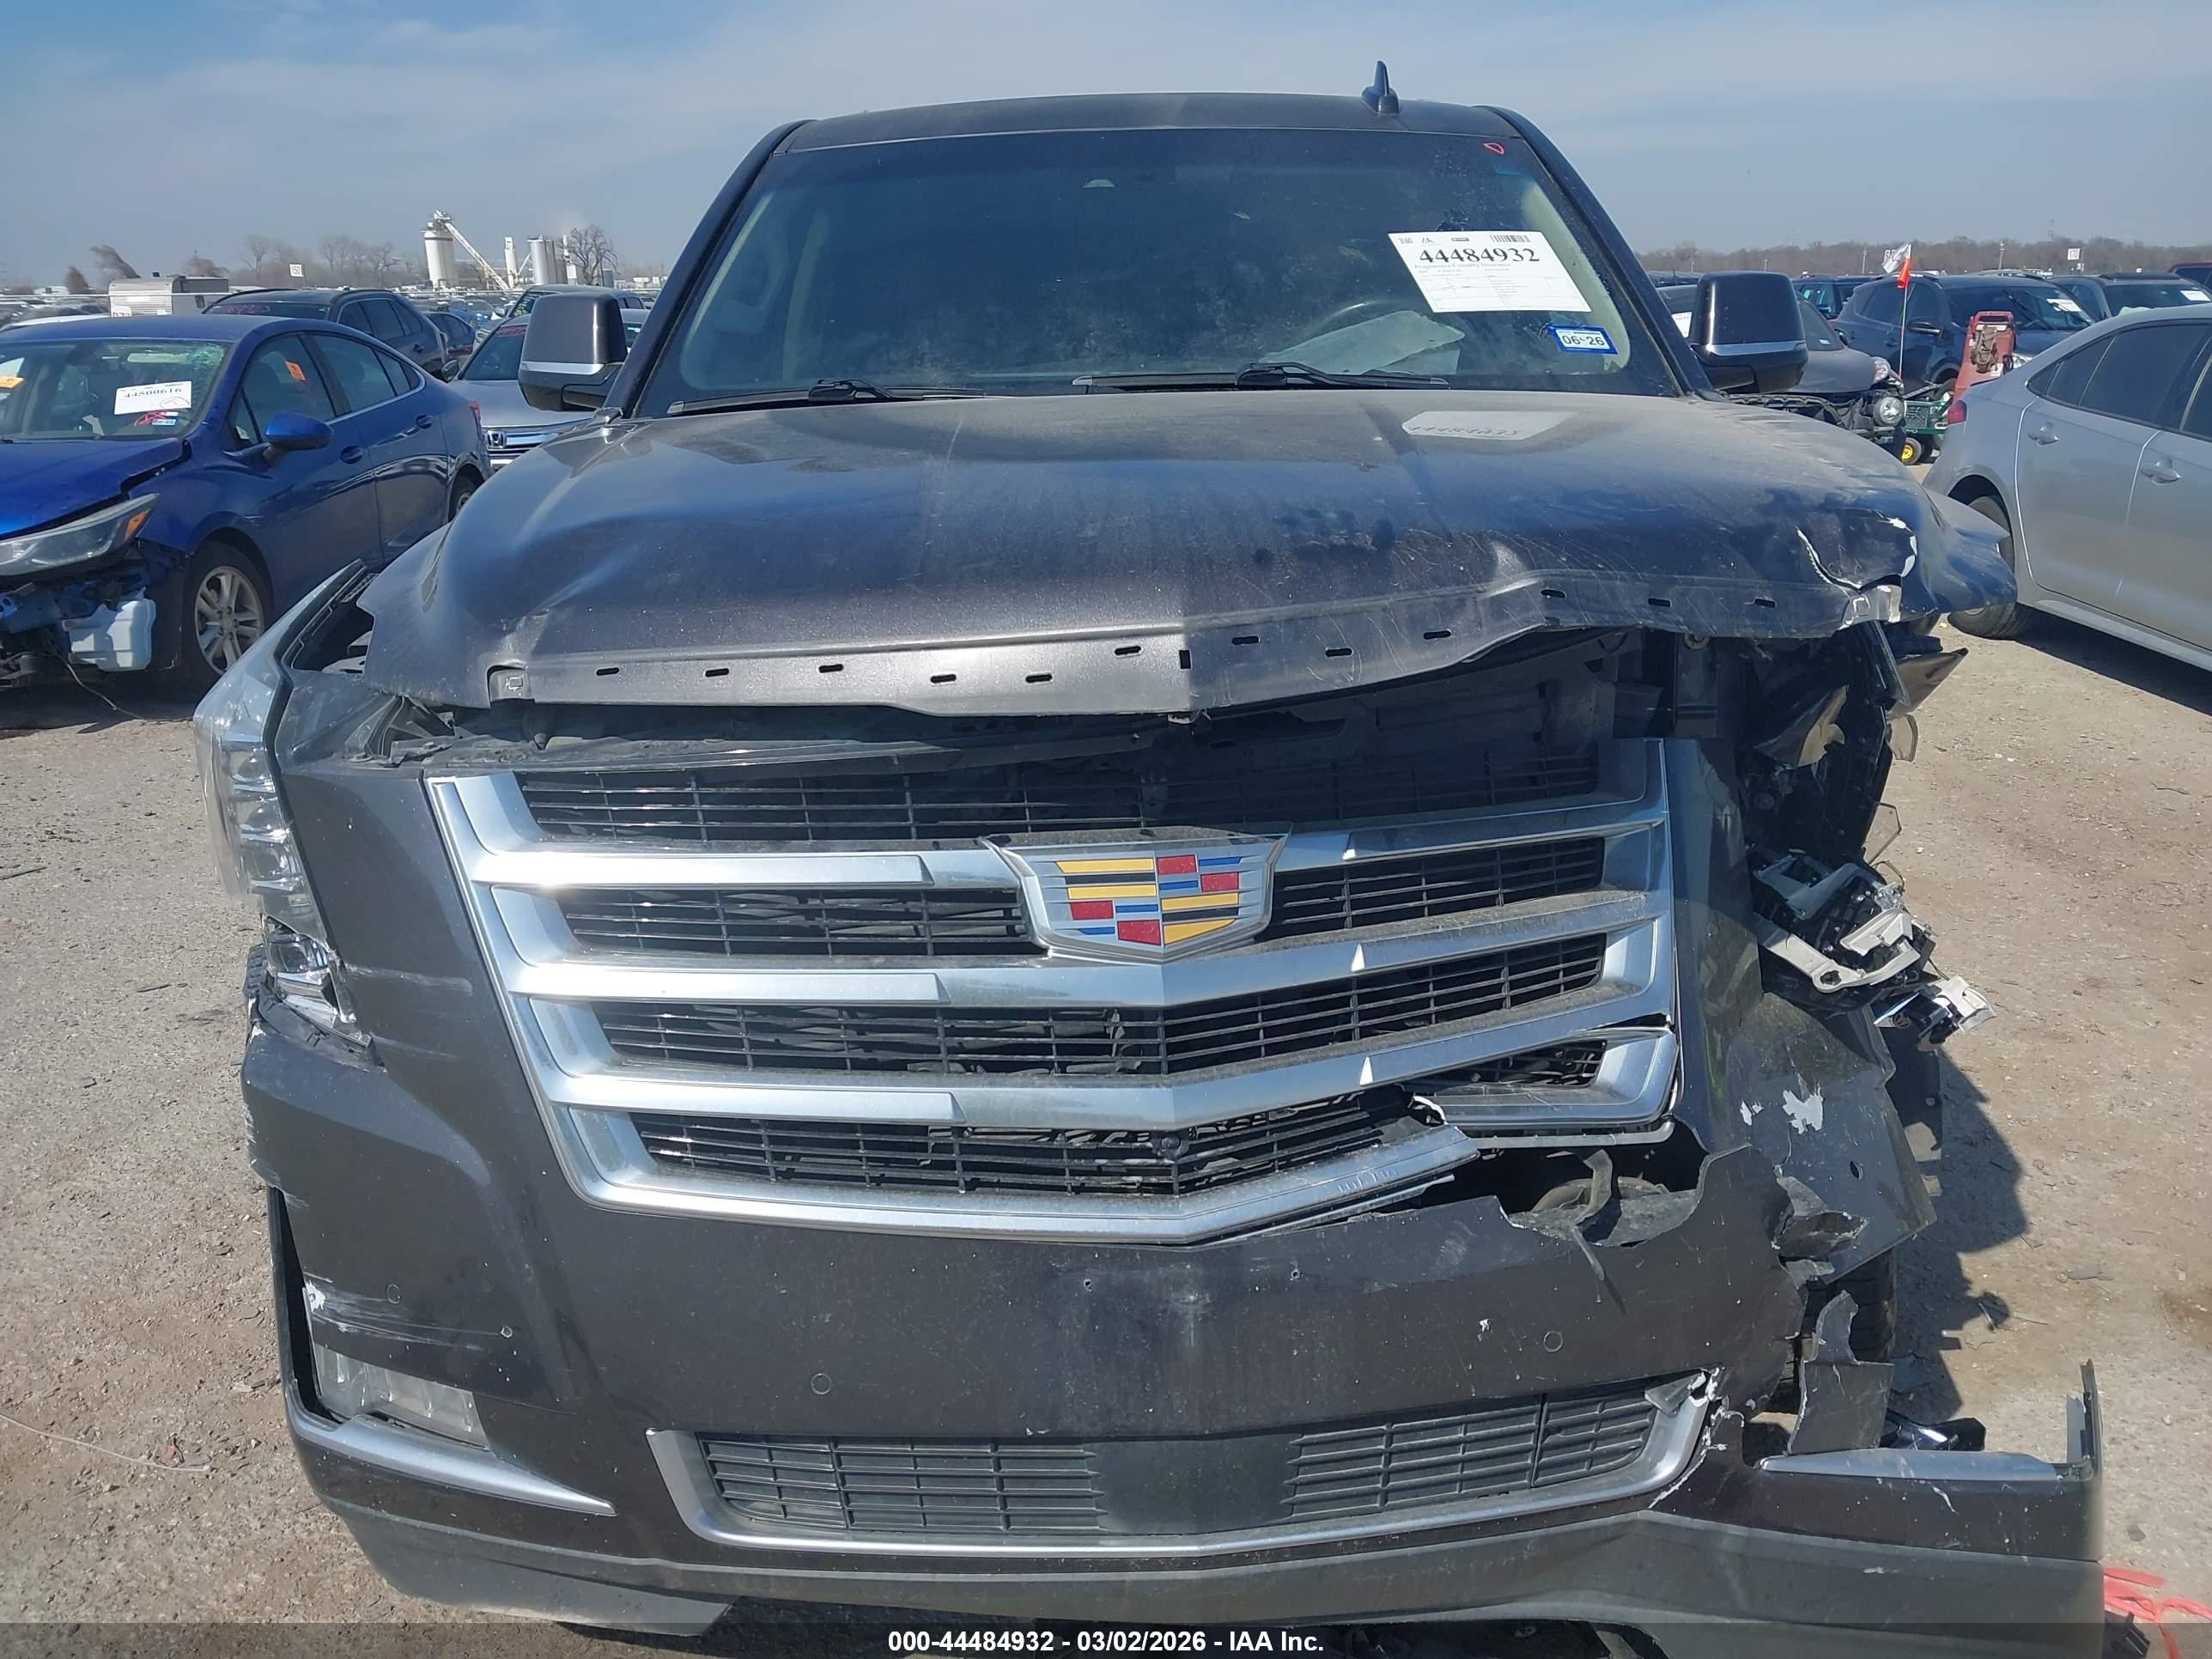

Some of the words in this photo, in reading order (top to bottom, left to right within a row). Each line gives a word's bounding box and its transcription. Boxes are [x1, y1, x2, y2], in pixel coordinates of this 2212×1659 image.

[1419, 247, 1540, 263] 44484932
[1561, 335, 1581, 345] 06
[1585, 336, 1606, 346] 26
